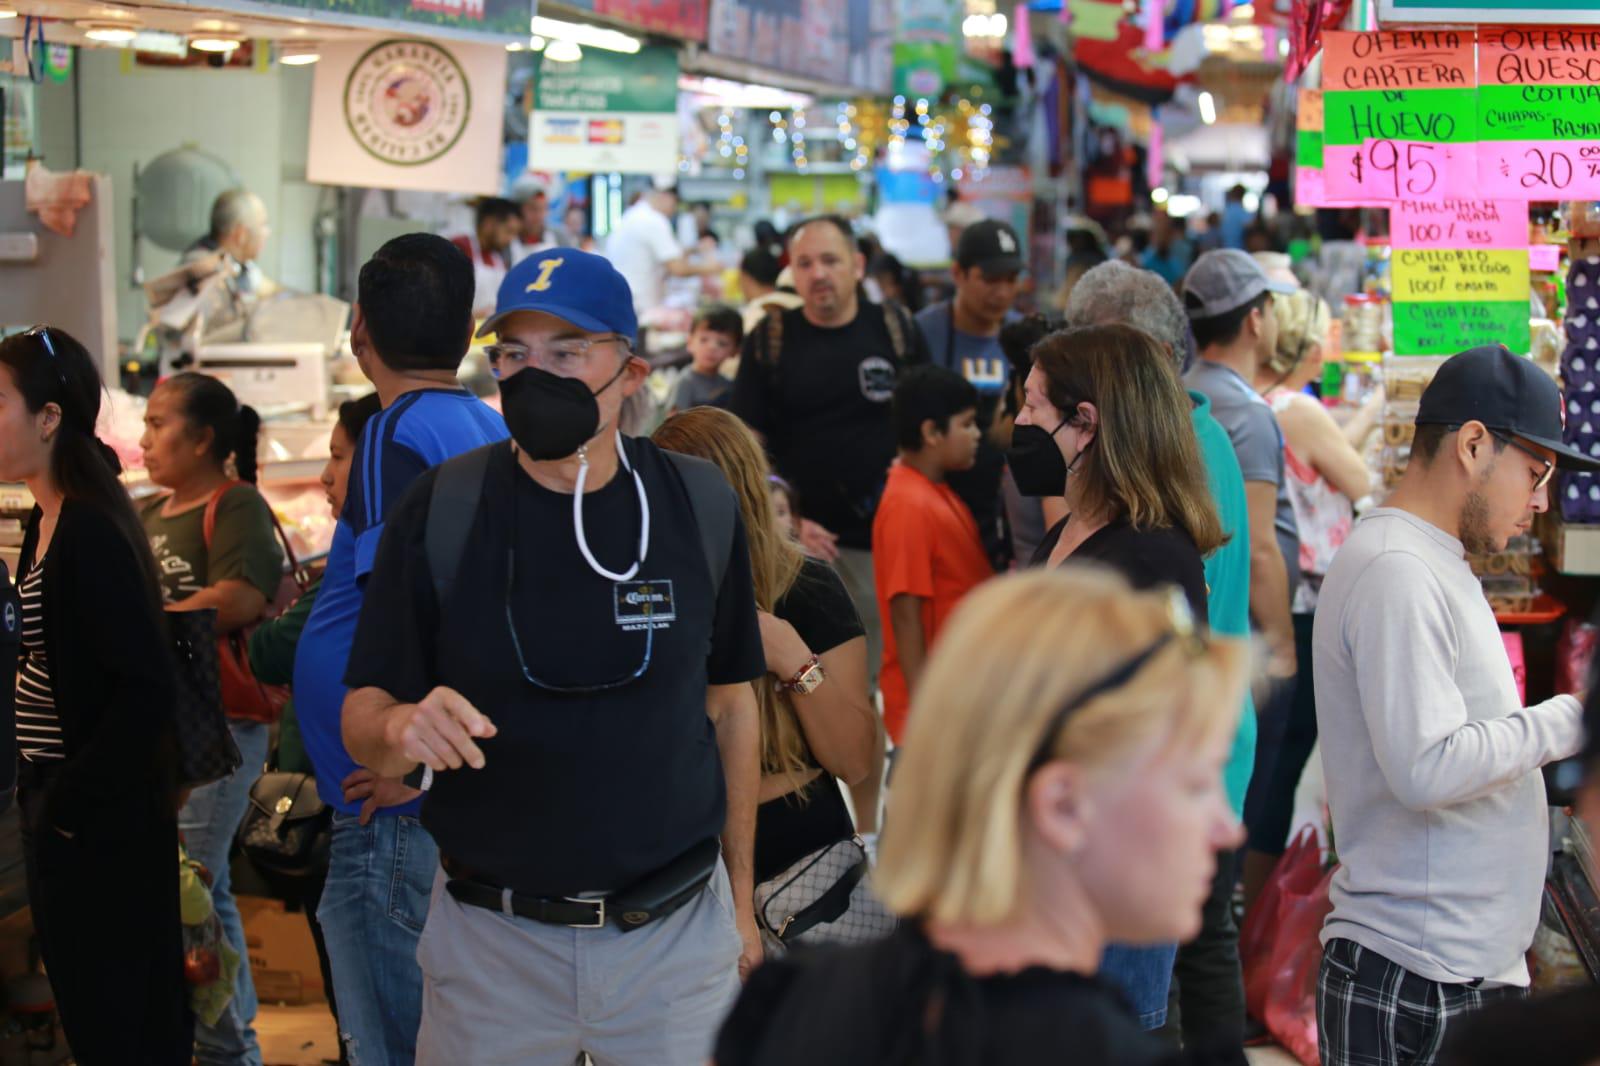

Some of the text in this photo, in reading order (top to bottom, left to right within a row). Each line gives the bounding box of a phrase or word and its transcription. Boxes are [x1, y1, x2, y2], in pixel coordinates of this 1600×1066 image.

[1353, 31, 1459, 58] OFERTA
[1344, 64, 1465, 89] CARTERA
[1382, 90, 1407, 102] DE
[1522, 86, 1600, 104] COTIJA
[1350, 104, 1455, 141] HUEVO
[1553, 118, 1600, 138] RAYA
[622, 622, 670, 631] MAZALAN
